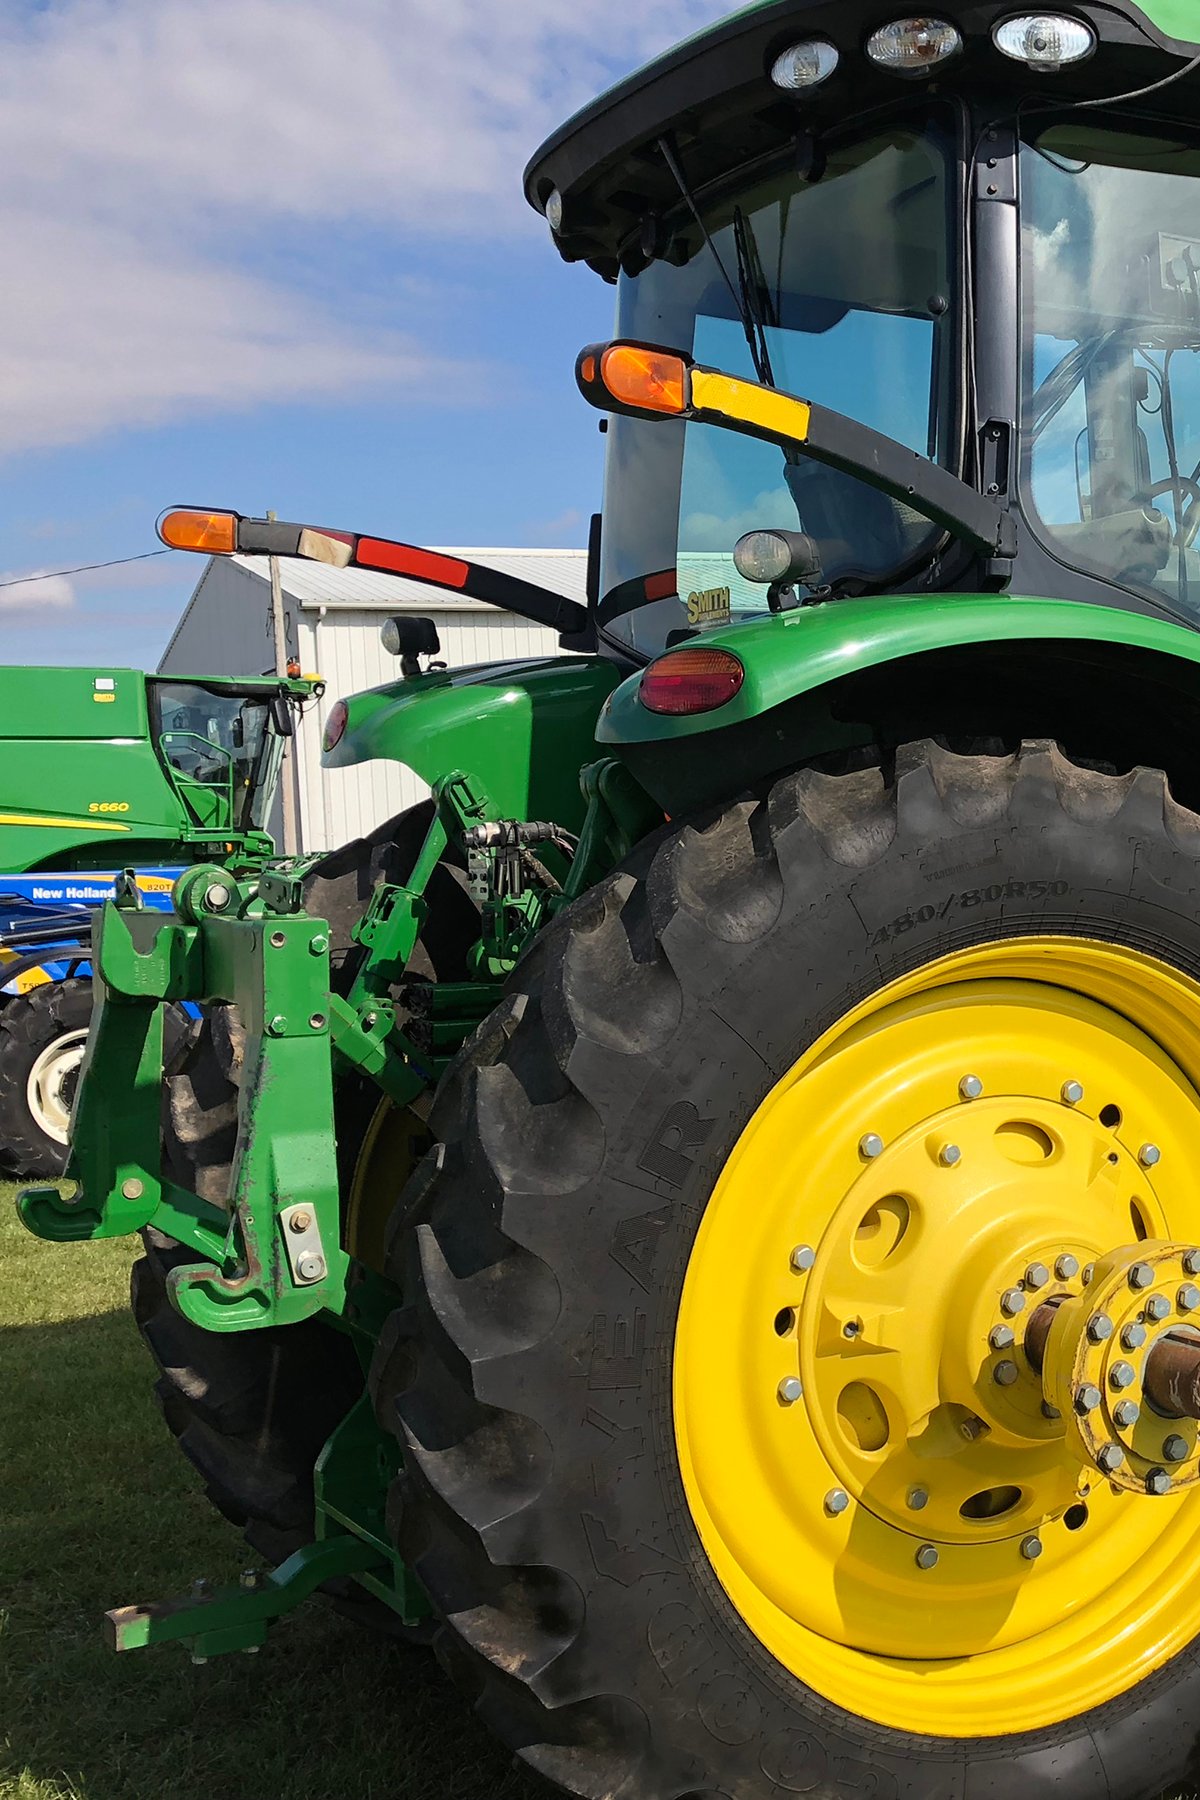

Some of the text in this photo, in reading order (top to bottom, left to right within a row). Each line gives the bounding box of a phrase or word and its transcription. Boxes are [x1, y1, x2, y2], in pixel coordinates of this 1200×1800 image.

[688, 586, 730, 624] SMITH
[88, 802, 129, 812] S660
[32, 887, 117, 899] New Holland
[870, 879, 1070, 947] 480/80R50
